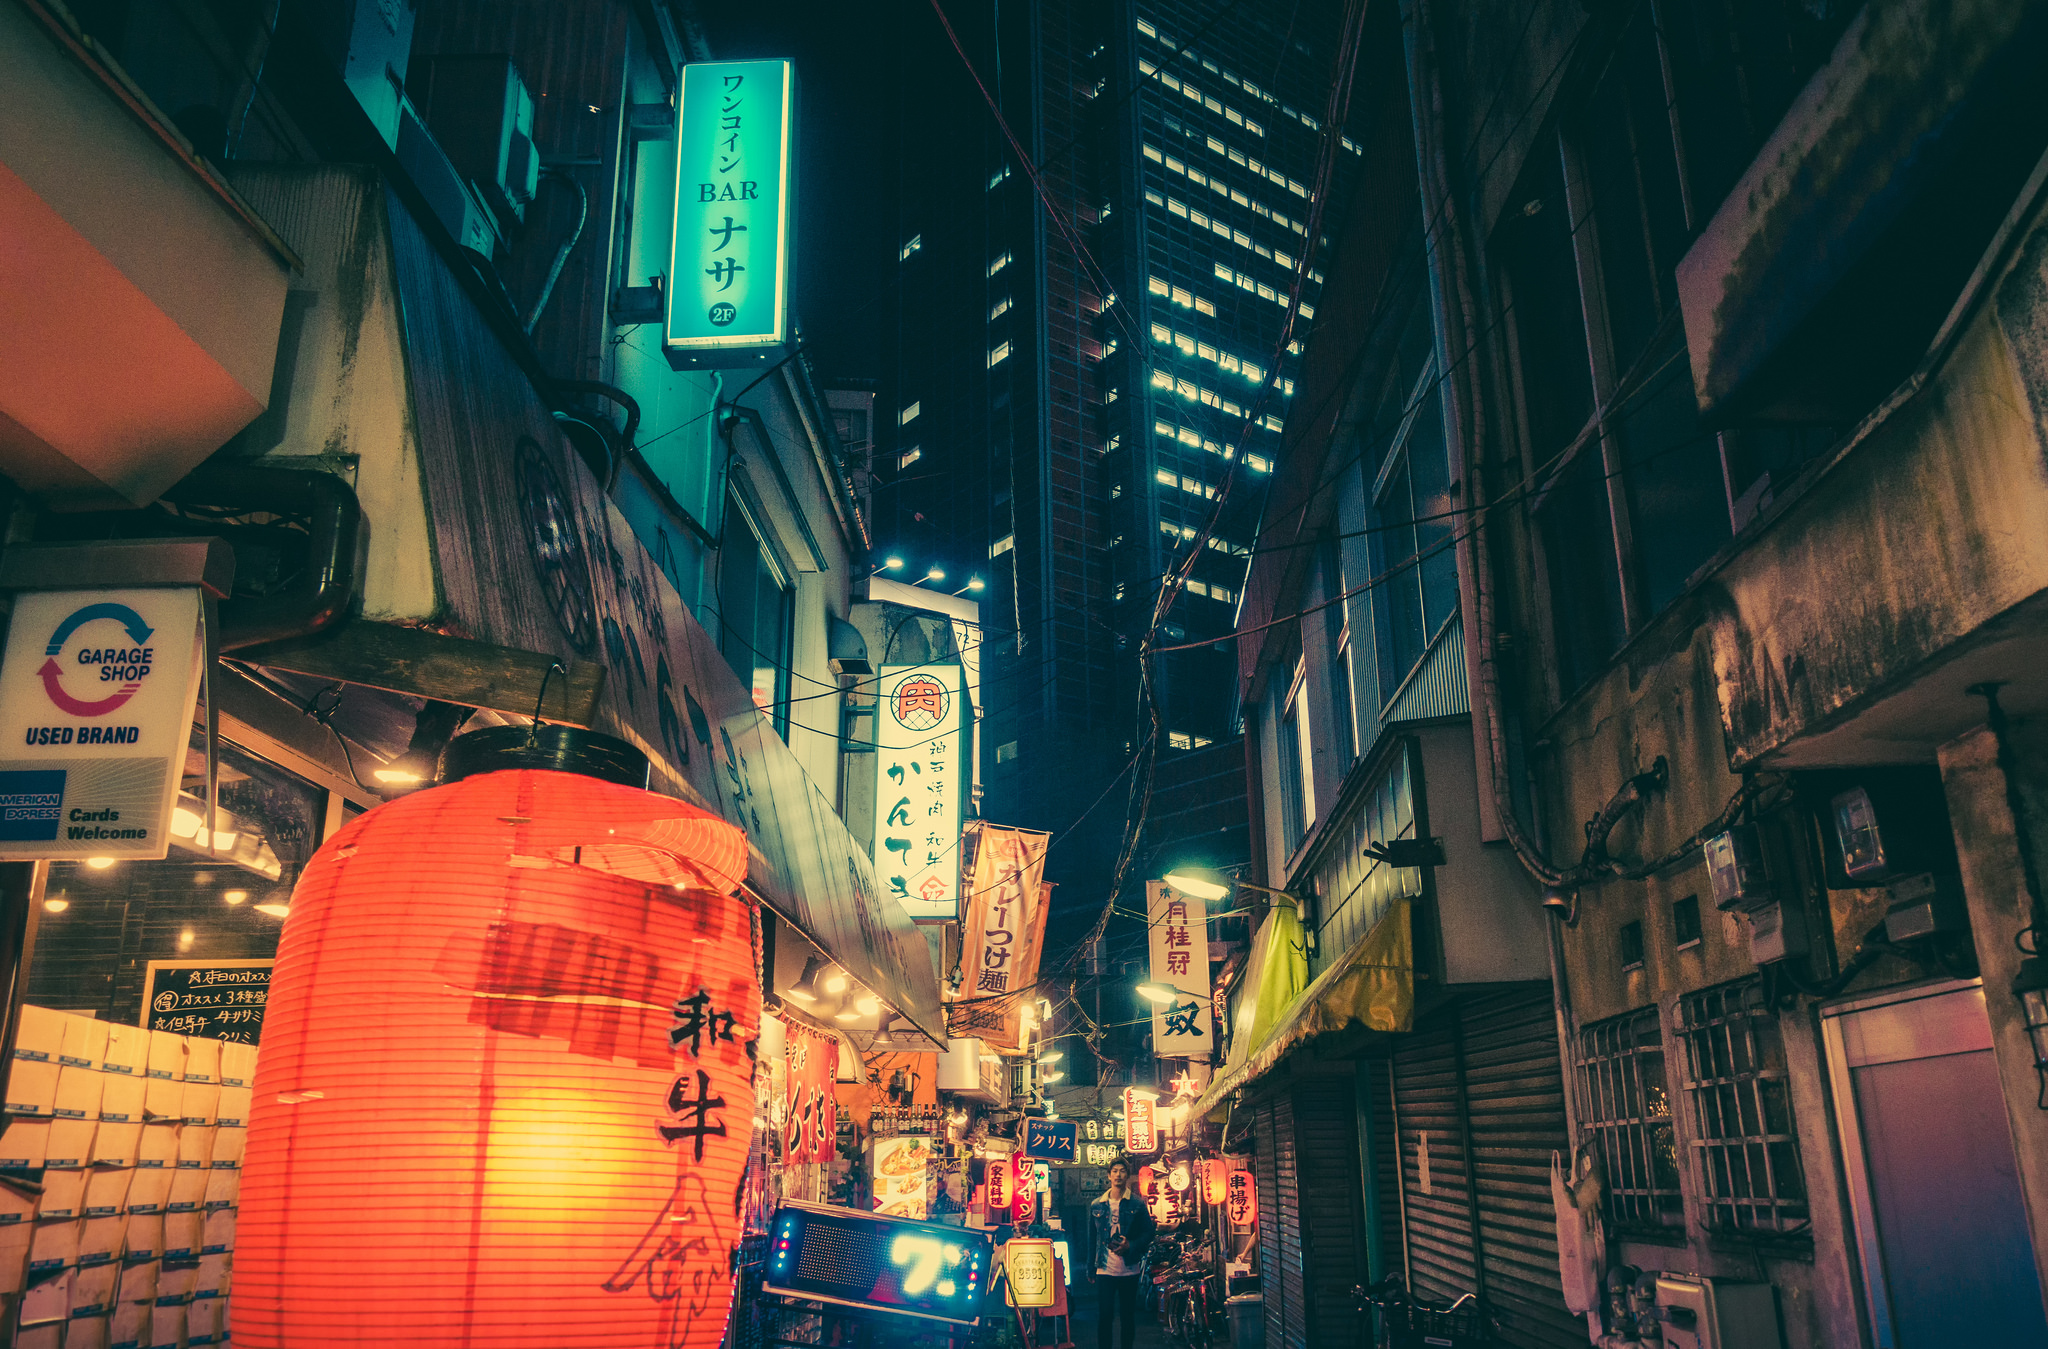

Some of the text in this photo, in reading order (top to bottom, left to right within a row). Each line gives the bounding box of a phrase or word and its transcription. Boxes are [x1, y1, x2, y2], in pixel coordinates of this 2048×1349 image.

[719, 75, 744, 174] ワンコイン
[697, 181, 759, 202] BAR
[705, 217, 747, 293] ナサ
[712, 307, 734, 323] 2F
[78, 648, 153, 664] GARAGE
[100, 665, 150, 681] SHOP
[26, 727, 139, 745] USED BRAND
[5, 808, 61, 820] EXPRESS
[69, 808, 119, 822] Cards
[67, 826, 147, 840] Welcome
[977, 864, 1023, 994] カレーつけ麺
[1164, 902, 1192, 975] 月桂冠
[181, 993, 221, 1005] オススメ
[659, 985, 738, 1163] 和牛
[1031, 1123, 1054, 1131] スナック
[1031, 1133, 1071, 1150] クリス
[990, 1165, 1003, 1206] 家庭料理
[1018, 1156, 1034, 1219] ワイン
[1230, 1174, 1250, 1221] 串揚げ
